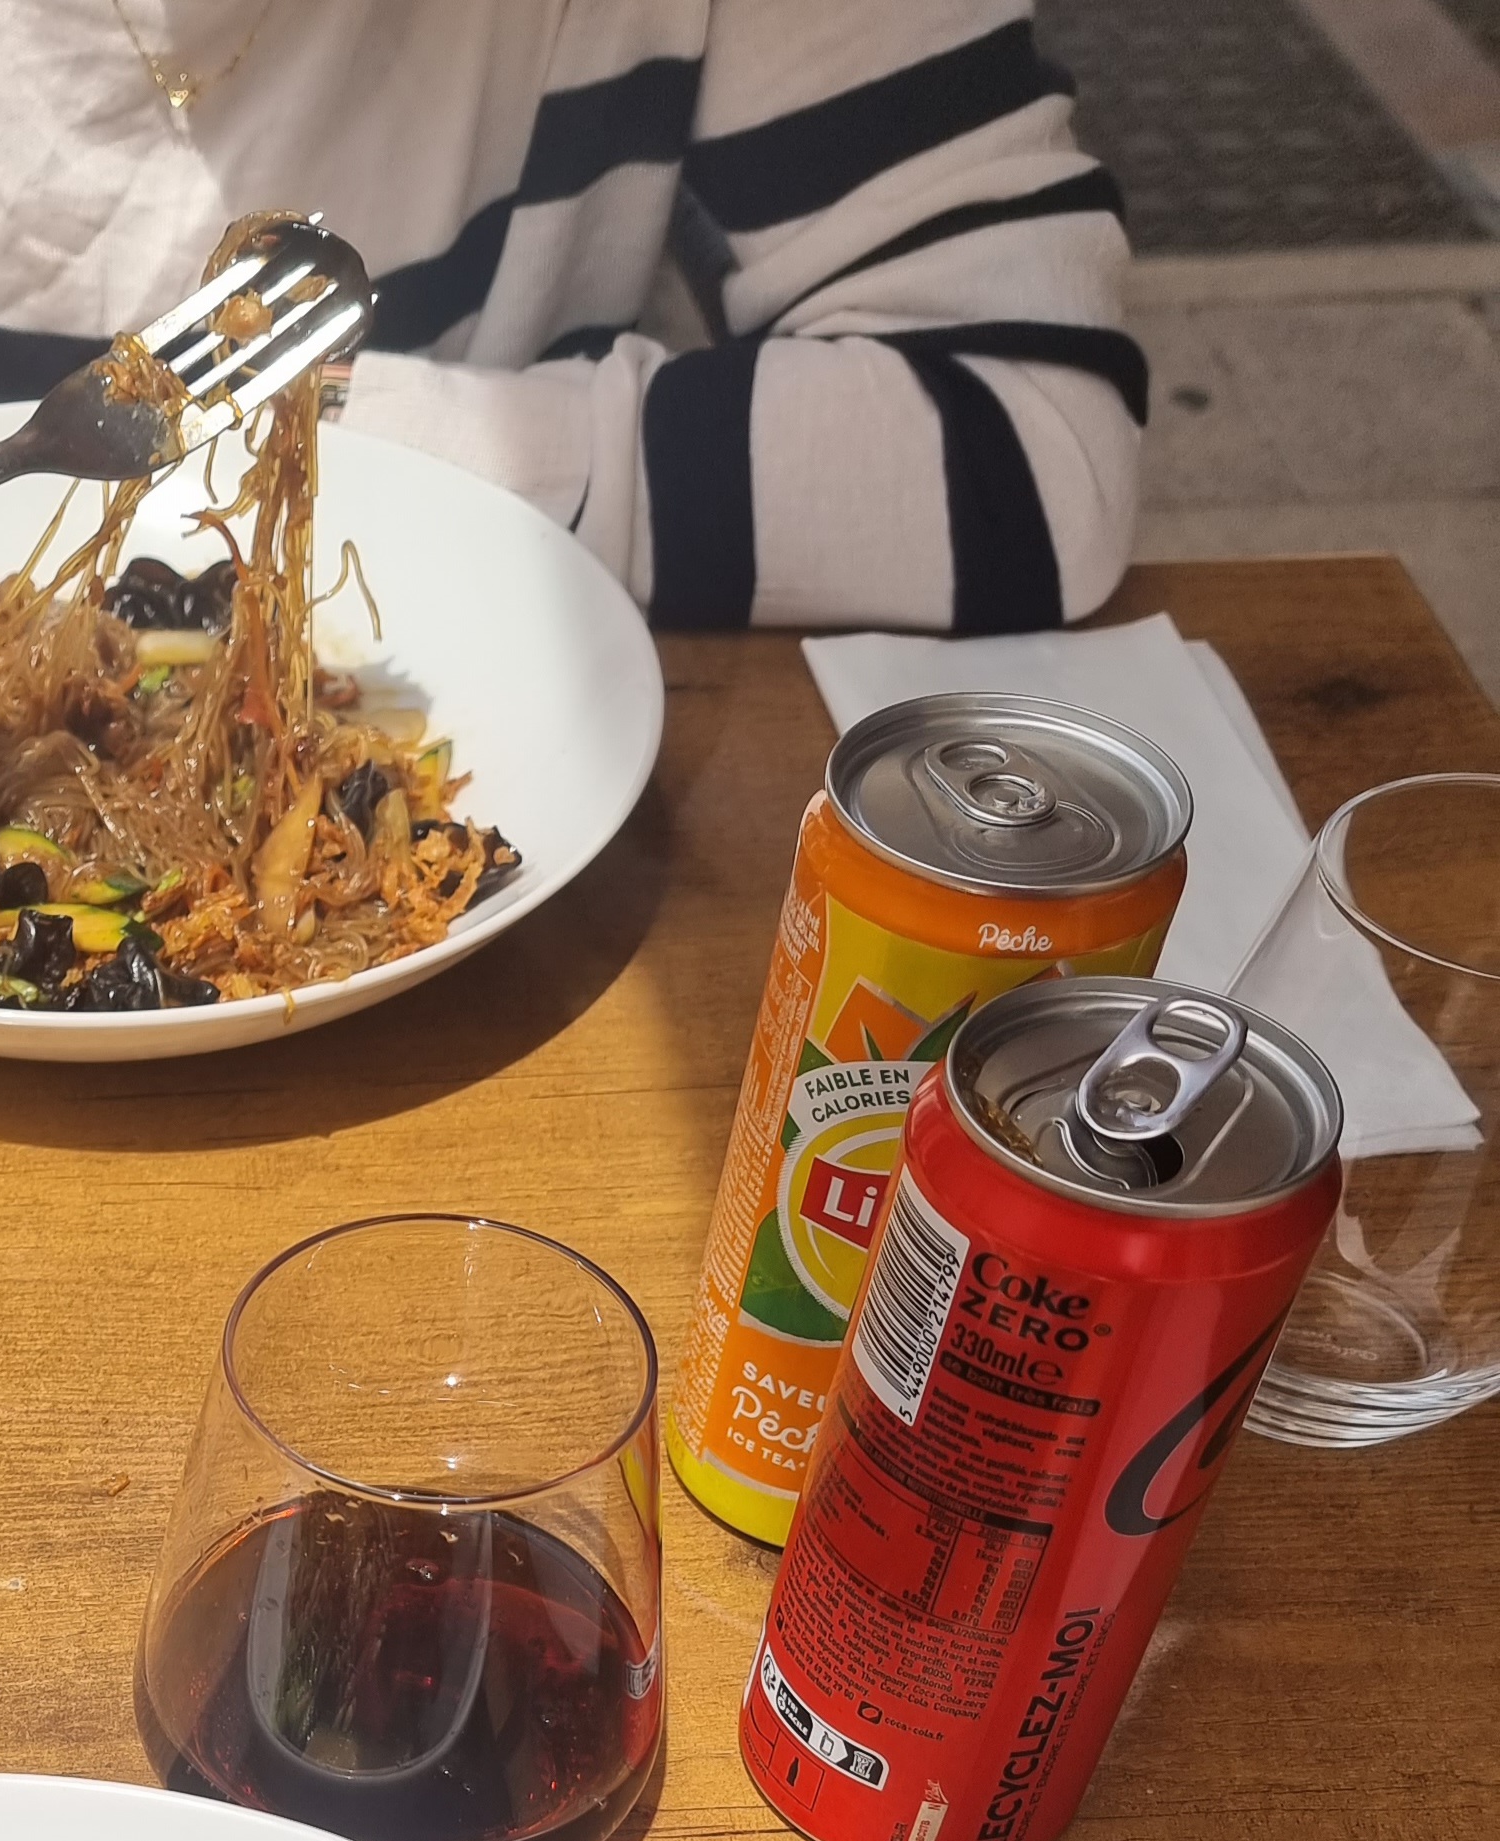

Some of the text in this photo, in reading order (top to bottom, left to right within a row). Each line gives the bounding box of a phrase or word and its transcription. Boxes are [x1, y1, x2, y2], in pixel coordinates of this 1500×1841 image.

[978, 923, 1053, 951] Pêche
[805, 1069, 910, 1100] FAIBLE EN
[811, 1090, 911, 1124] CALORIES
[972, 1252, 1090, 1320] Coke
[900, 1406, 912, 1422] 5
[908, 1330, 938, 1399] 449000
[929, 1252, 960, 1327] 214799
[959, 1285, 1090, 1352] ZERO
[967, 1366, 1003, 1390] boit
[1010, 1384, 1045, 1405] très
[1052, 1398, 1094, 1414] frais
[731, 1385, 821, 1453] Pêch
[727, 1427, 797, 1471] ICE TEA
[784, 1709, 808, 1736] FACILE
[787, 1696, 798, 1714] TRI
[884, 1716, 945, 1742] coca-cola.fr
